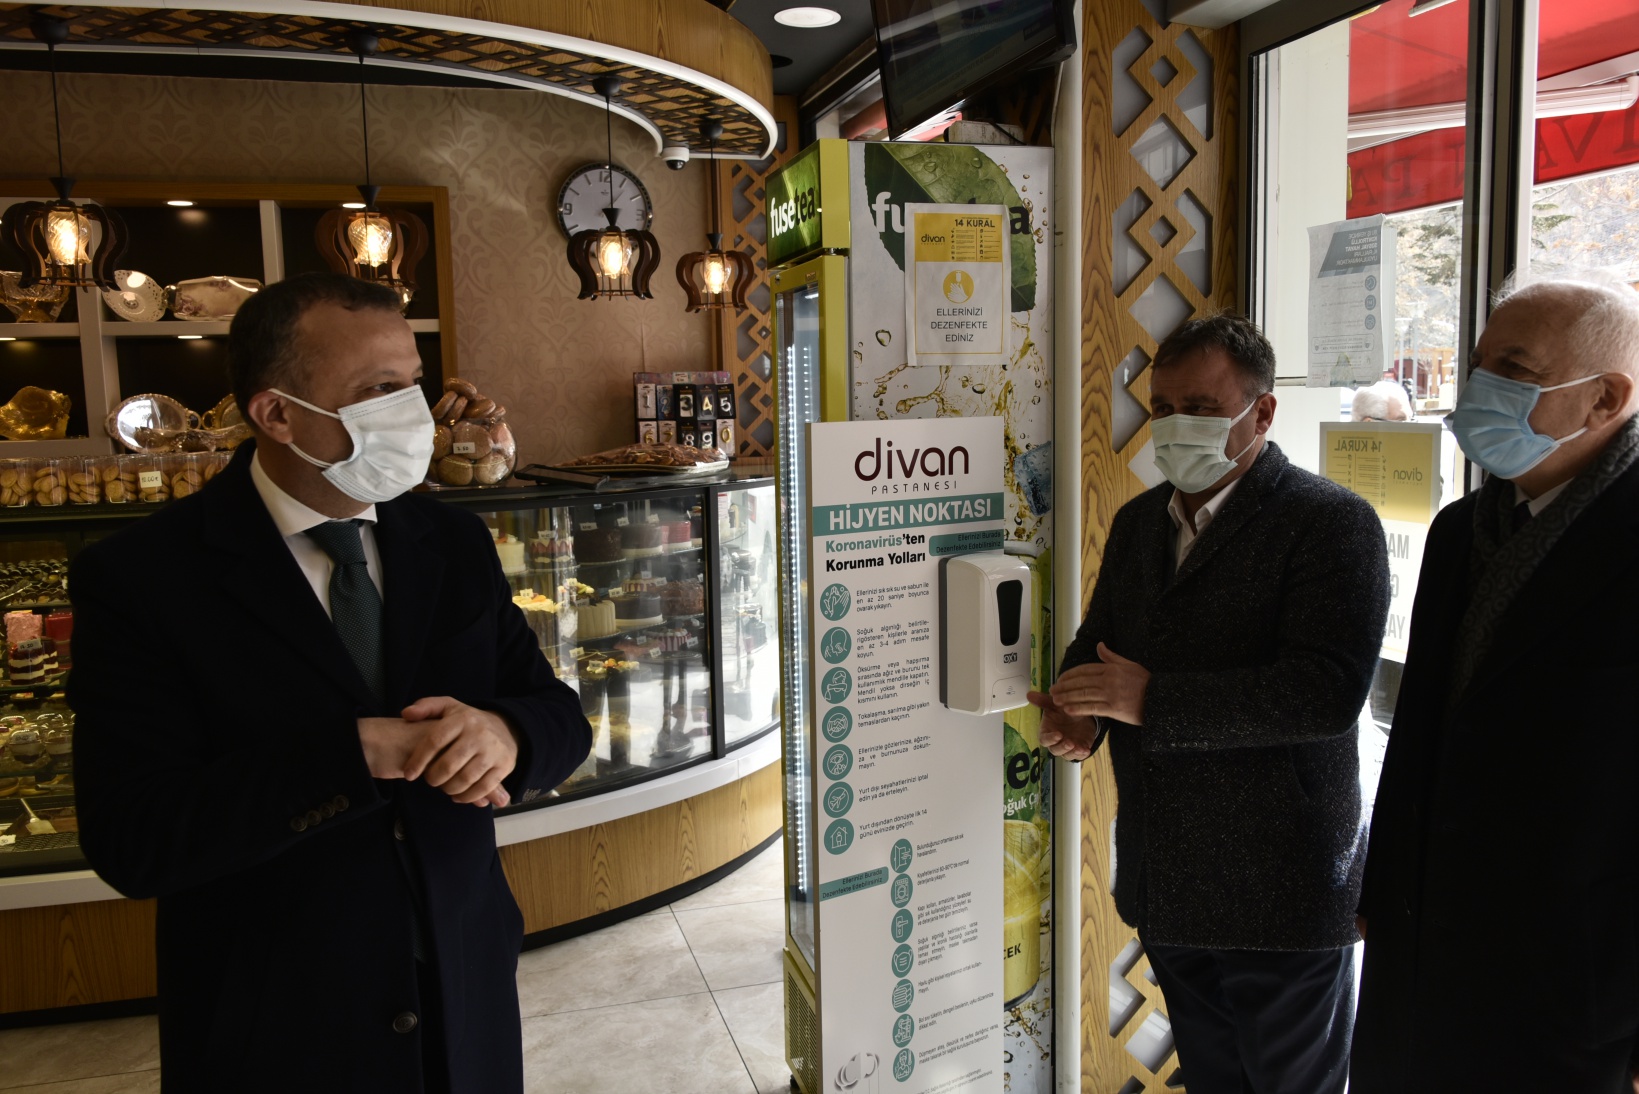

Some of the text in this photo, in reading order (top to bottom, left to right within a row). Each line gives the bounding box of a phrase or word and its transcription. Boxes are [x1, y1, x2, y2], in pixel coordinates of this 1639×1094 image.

[564, 203, 573, 216] 9
[921, 234, 945, 242] divan
[936, 306, 983, 317] ELLERİNİZİ
[931, 321, 988, 330] DEZENFEKTE
[945, 332, 974, 342] EDİNİZ
[720, 397, 731, 412] 5
[854, 437, 969, 482] divan
[829, 499, 991, 530] HİJYEN NOKTASI
[958, 530, 1000, 542] Ellerinizi Burada
[936, 541, 1001, 553] Dezenfekte Edebilirsiniz
[826, 552, 926, 572] Korunma Yolları
[1004, 747, 1040, 789] ea
[1004, 796, 1027, 816] oğuk
[864, 869, 882, 879] Burada
[822, 886, 851, 899] Dezenfekte
[1004, 942, 1022, 961] EK
